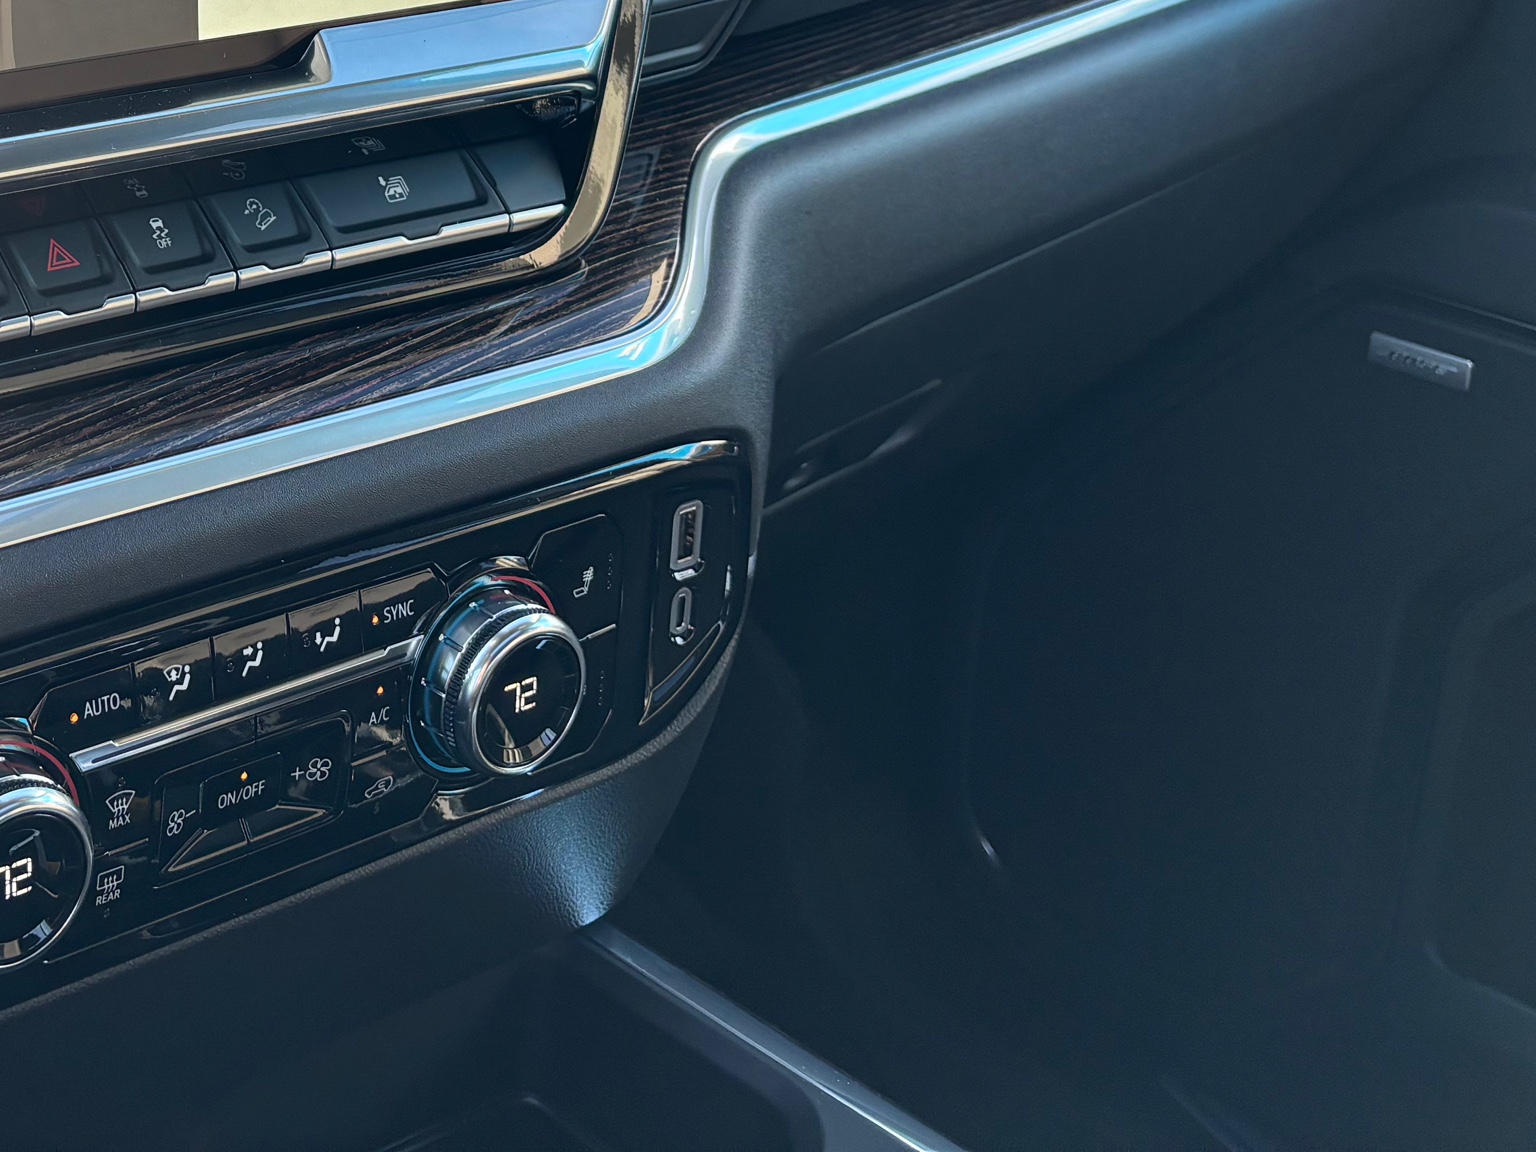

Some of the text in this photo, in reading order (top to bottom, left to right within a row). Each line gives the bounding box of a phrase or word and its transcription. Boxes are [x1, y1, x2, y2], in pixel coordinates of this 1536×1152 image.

[157, 238, 172, 249] OFF
[383, 599, 415, 624] SYNC
[84, 692, 120, 719] AUTO
[504, 676, 537, 714] 72
[369, 706, 390, 726] A/C
[218, 779, 266, 810] ON/OFF
[108, 814, 131, 829] MAX
[96, 889, 121, 906] REAR
